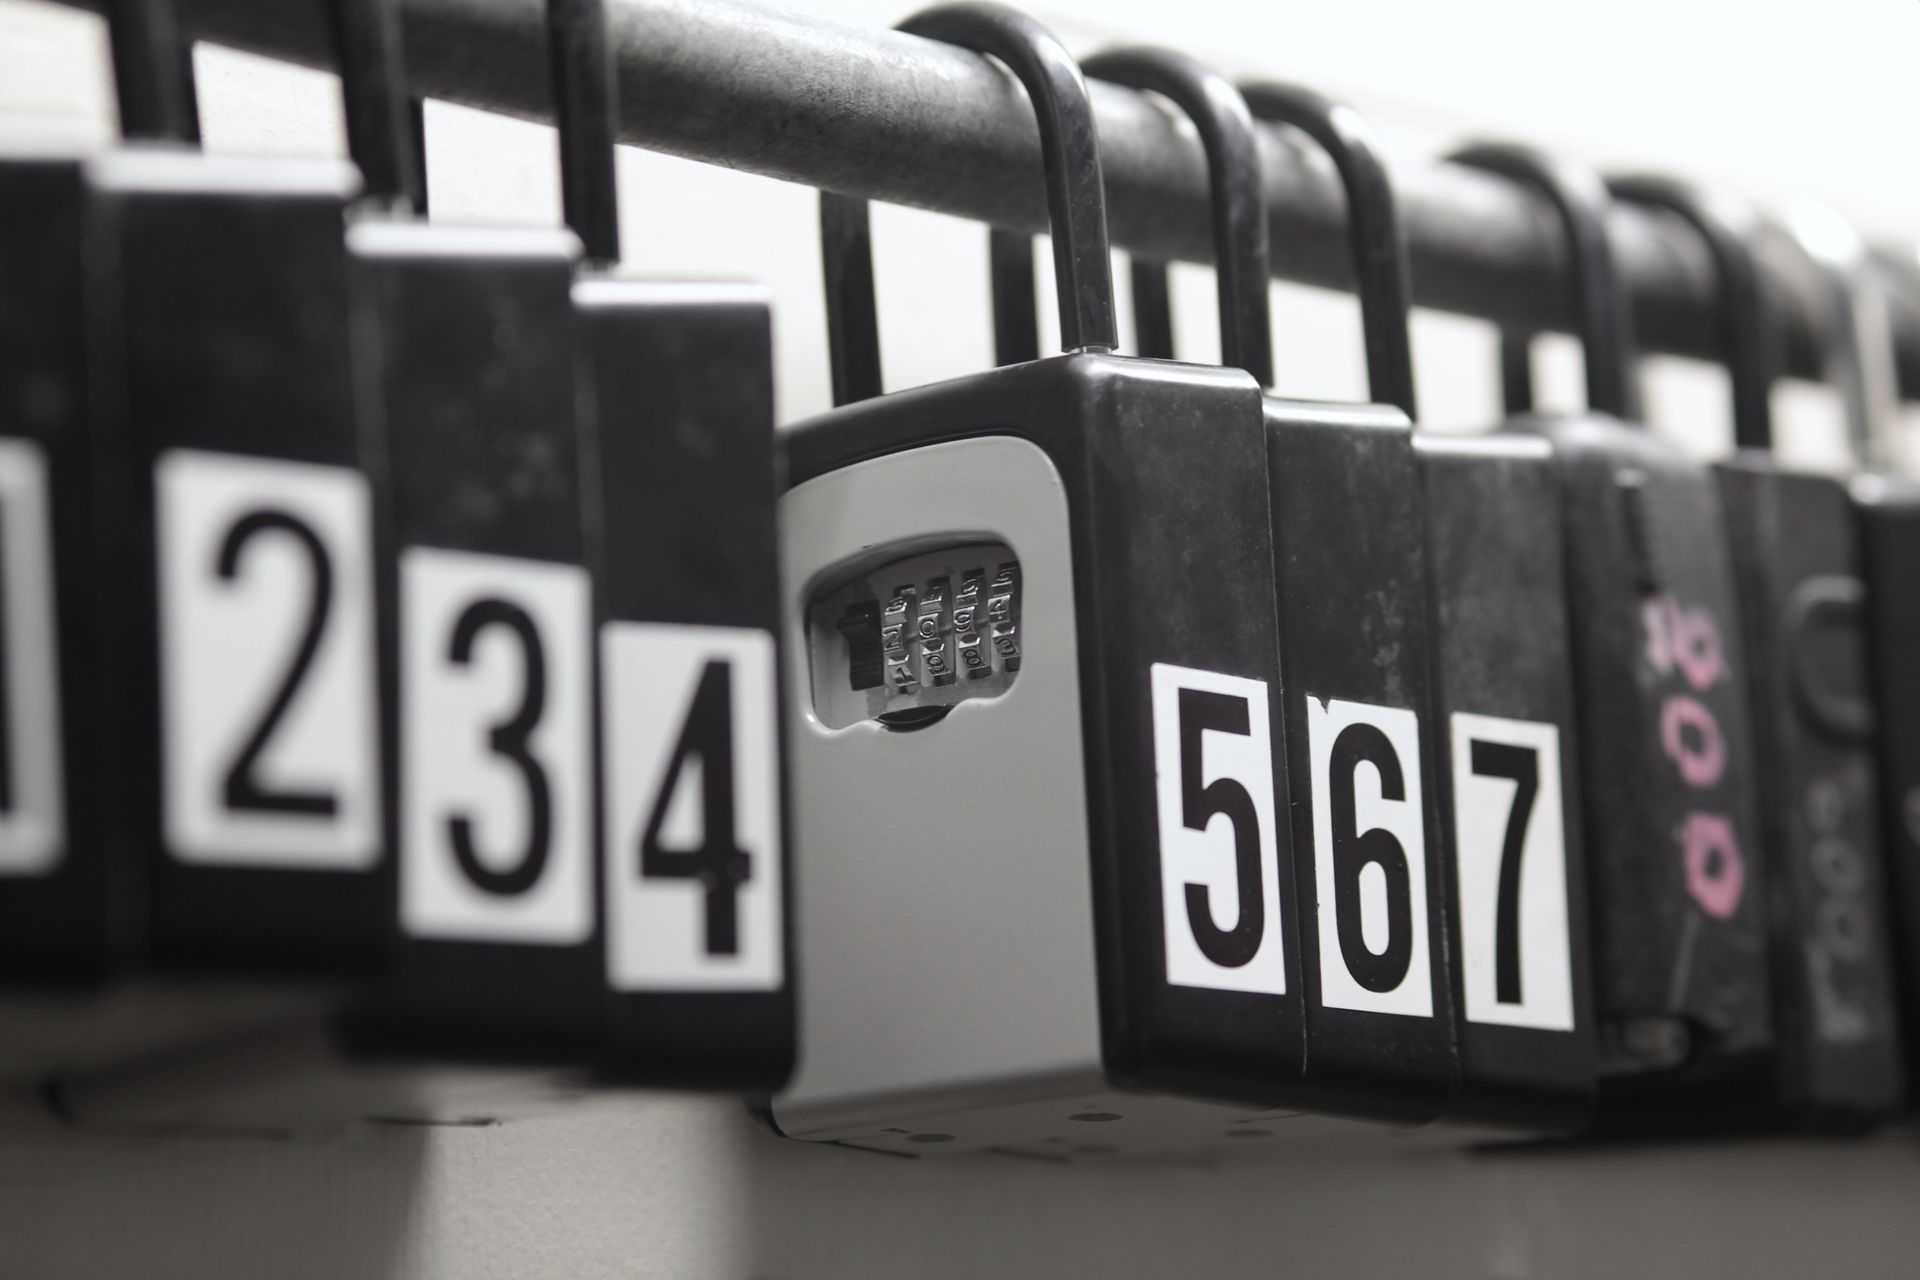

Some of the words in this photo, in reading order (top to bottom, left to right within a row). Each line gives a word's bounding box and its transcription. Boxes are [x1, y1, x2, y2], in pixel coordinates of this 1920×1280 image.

[215, 508, 339, 818] 2
[449, 597, 552, 897] 3
[641, 657, 752, 956] 4
[1178, 687, 1265, 968] 5
[1329, 722, 1413, 993] 6
[1469, 737, 1540, 1006] 7
